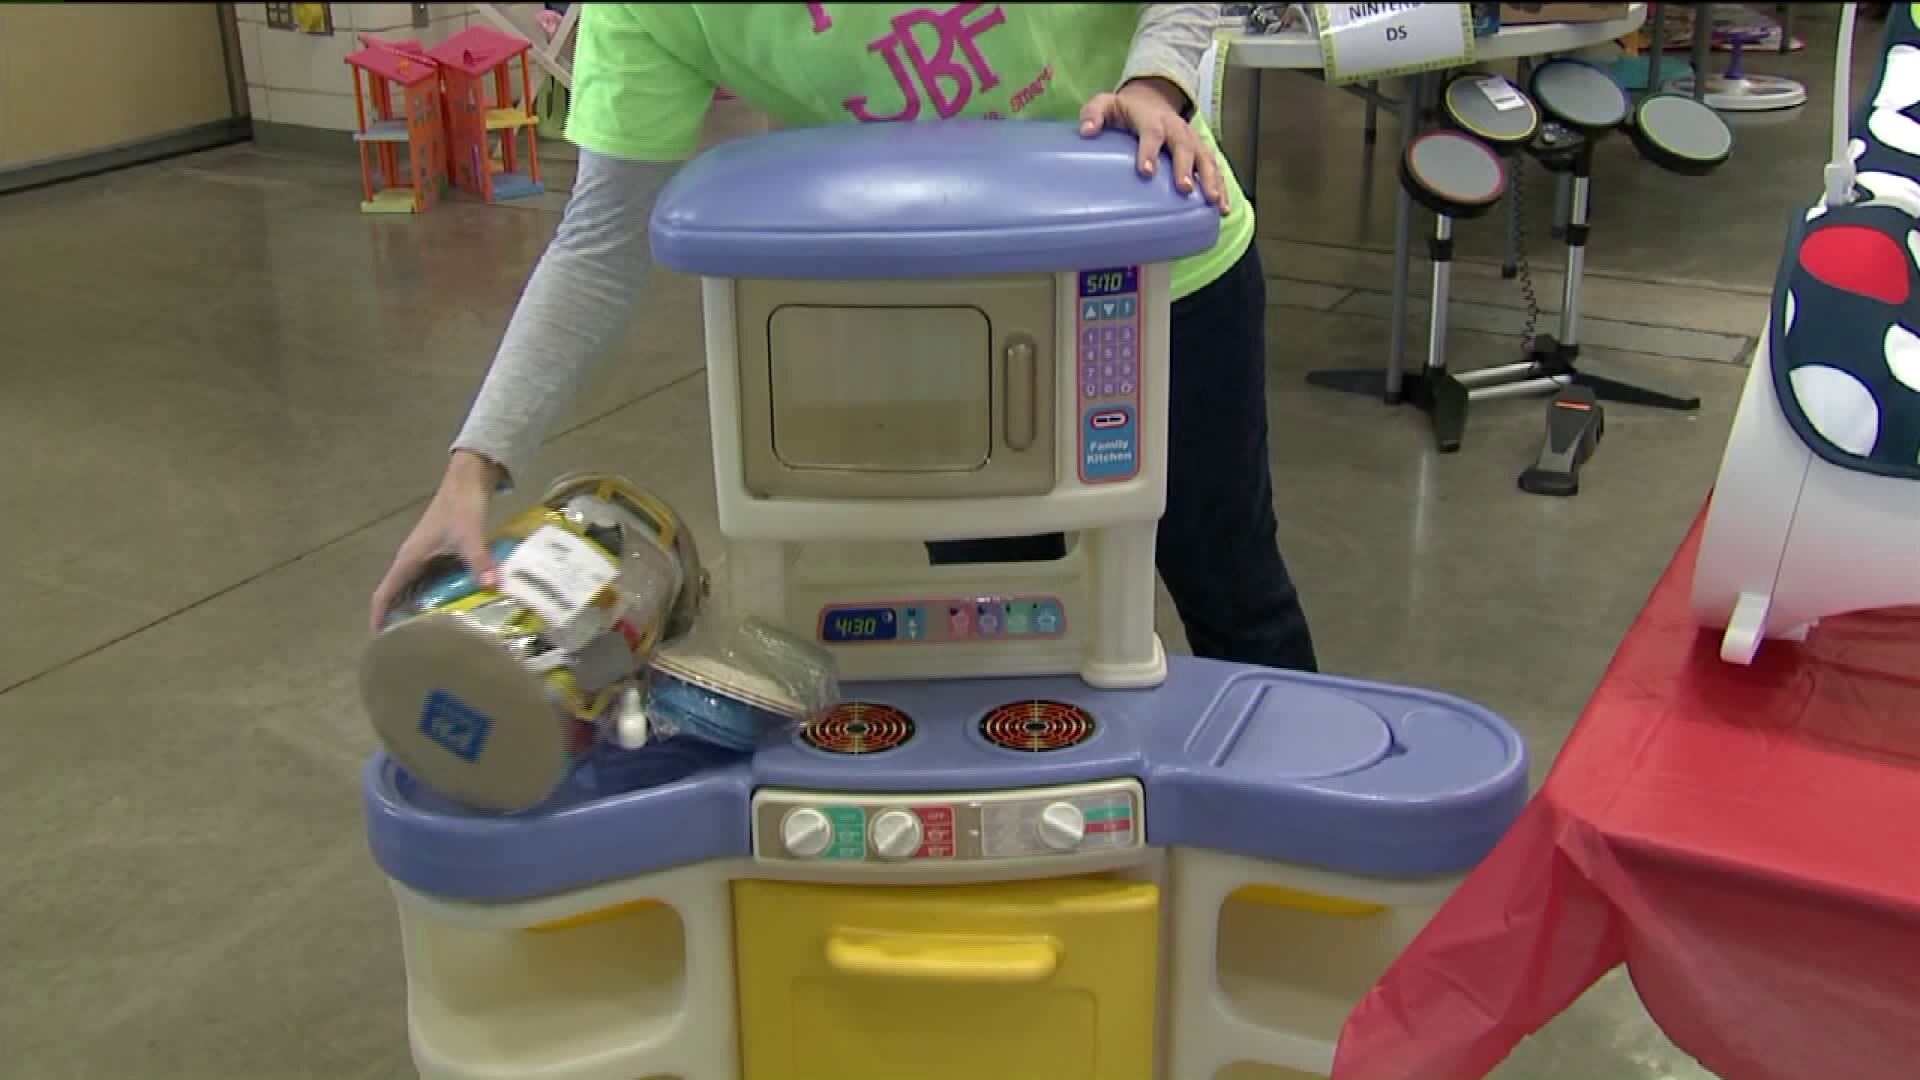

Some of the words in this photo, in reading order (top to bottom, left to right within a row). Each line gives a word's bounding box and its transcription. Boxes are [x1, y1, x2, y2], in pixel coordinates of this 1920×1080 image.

[1386, 25, 1407, 41] DS
[841, 2, 1007, 122] JBF
[1090, 440, 1128, 452] Family
[1087, 451, 1132, 464] Kitchen
